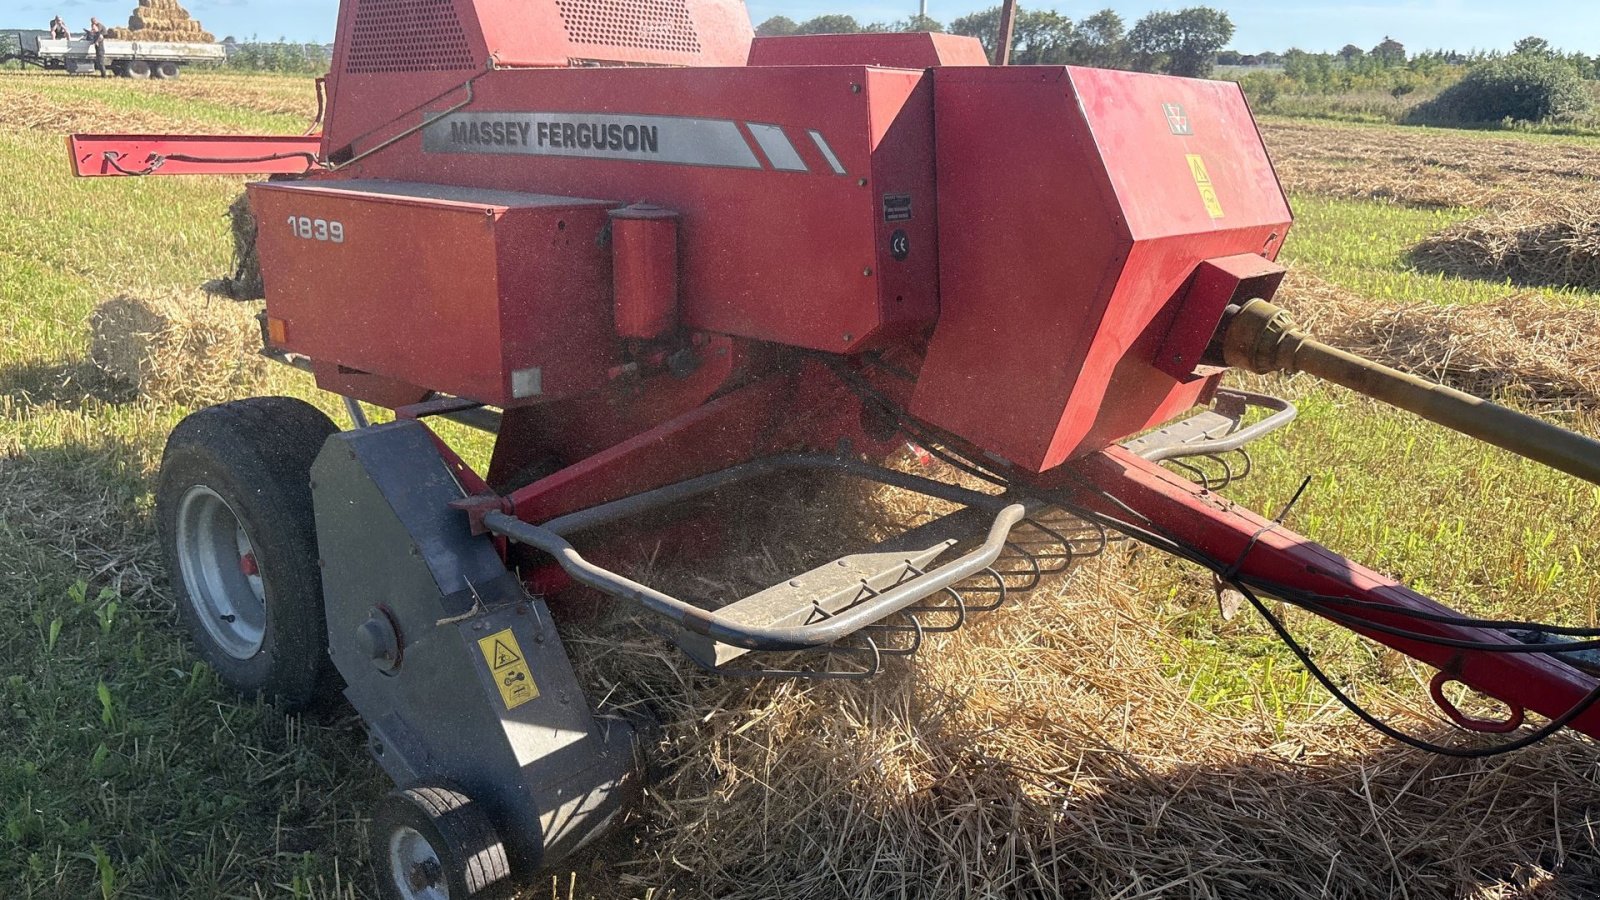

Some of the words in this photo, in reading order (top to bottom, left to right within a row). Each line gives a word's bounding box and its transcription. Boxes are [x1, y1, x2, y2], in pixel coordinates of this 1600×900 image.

[450, 121, 530, 146] MASSEY
[537, 122, 659, 152] FERGUSON
[287, 215, 344, 243] 1839
[893, 237, 906, 253] CE
